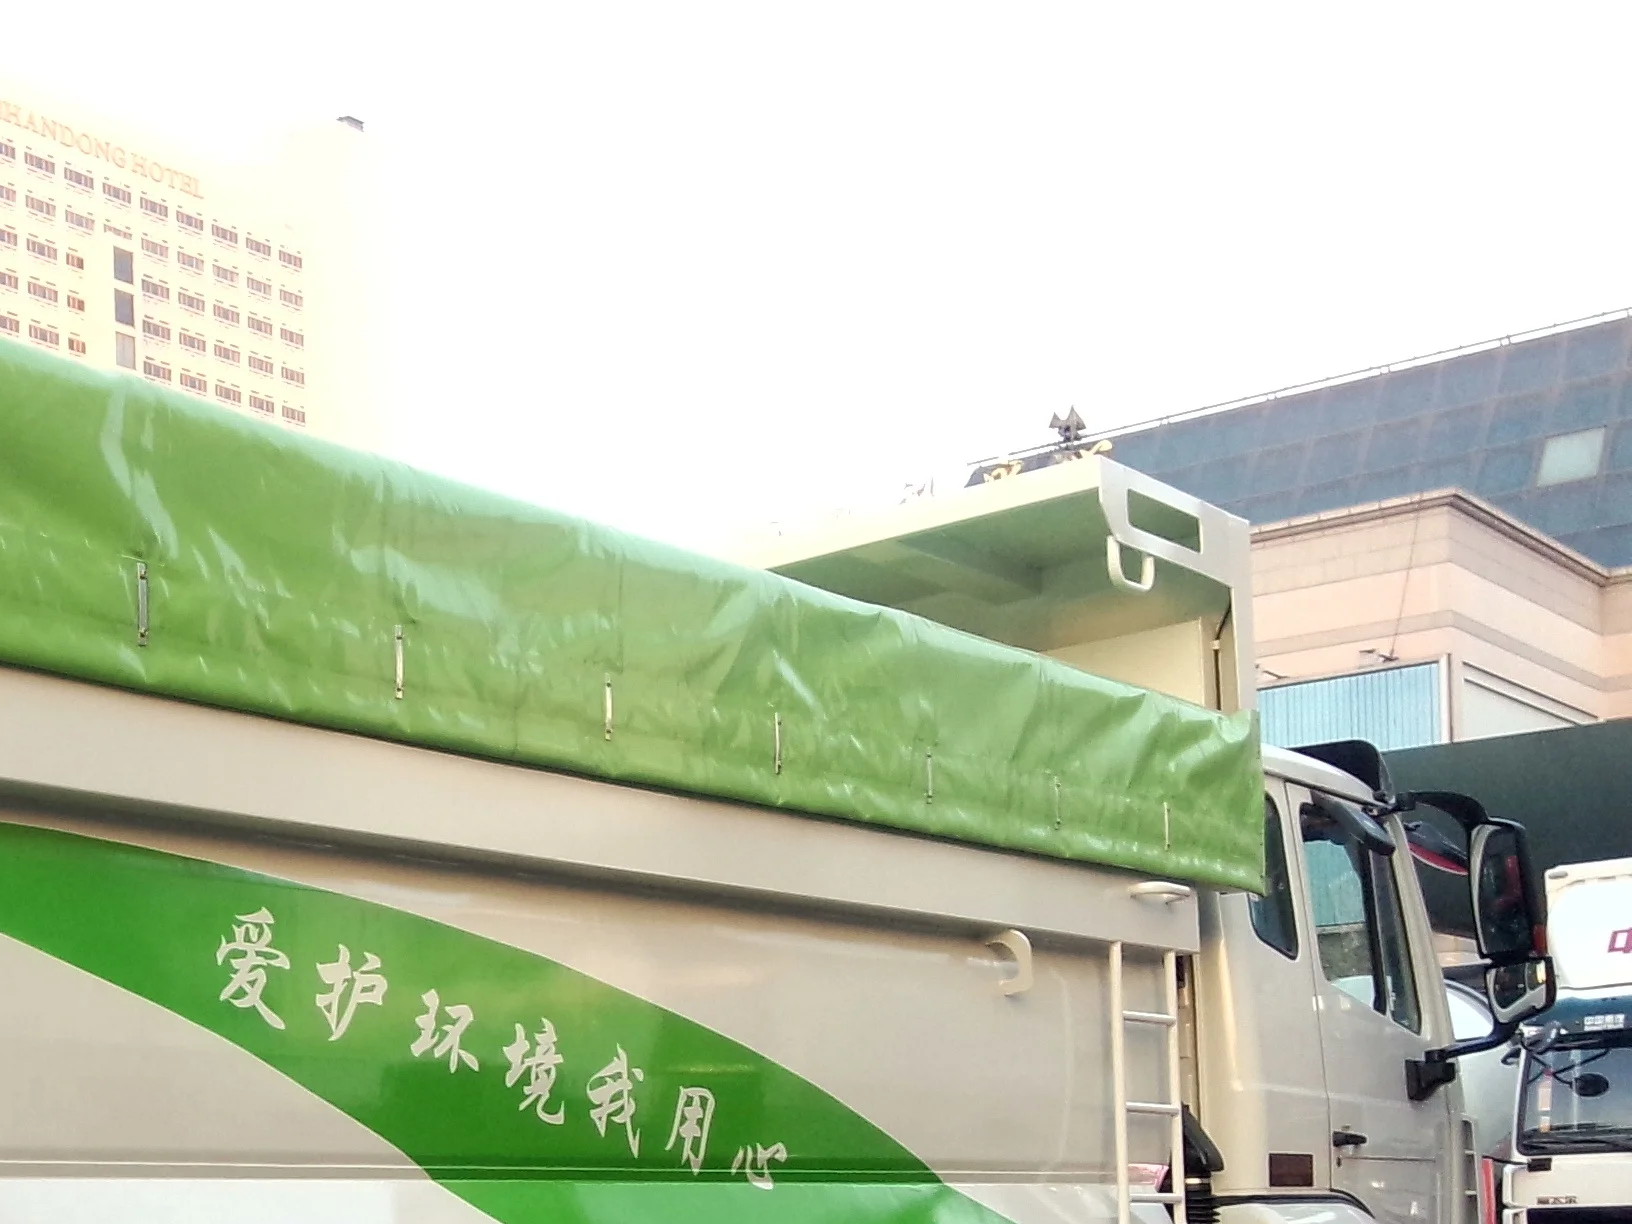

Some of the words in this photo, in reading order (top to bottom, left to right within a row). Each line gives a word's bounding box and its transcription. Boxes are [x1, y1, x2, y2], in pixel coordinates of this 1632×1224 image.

[130, 151, 205, 200] HOTEL
[215, 905, 788, 1190] 爱护环境我用心
